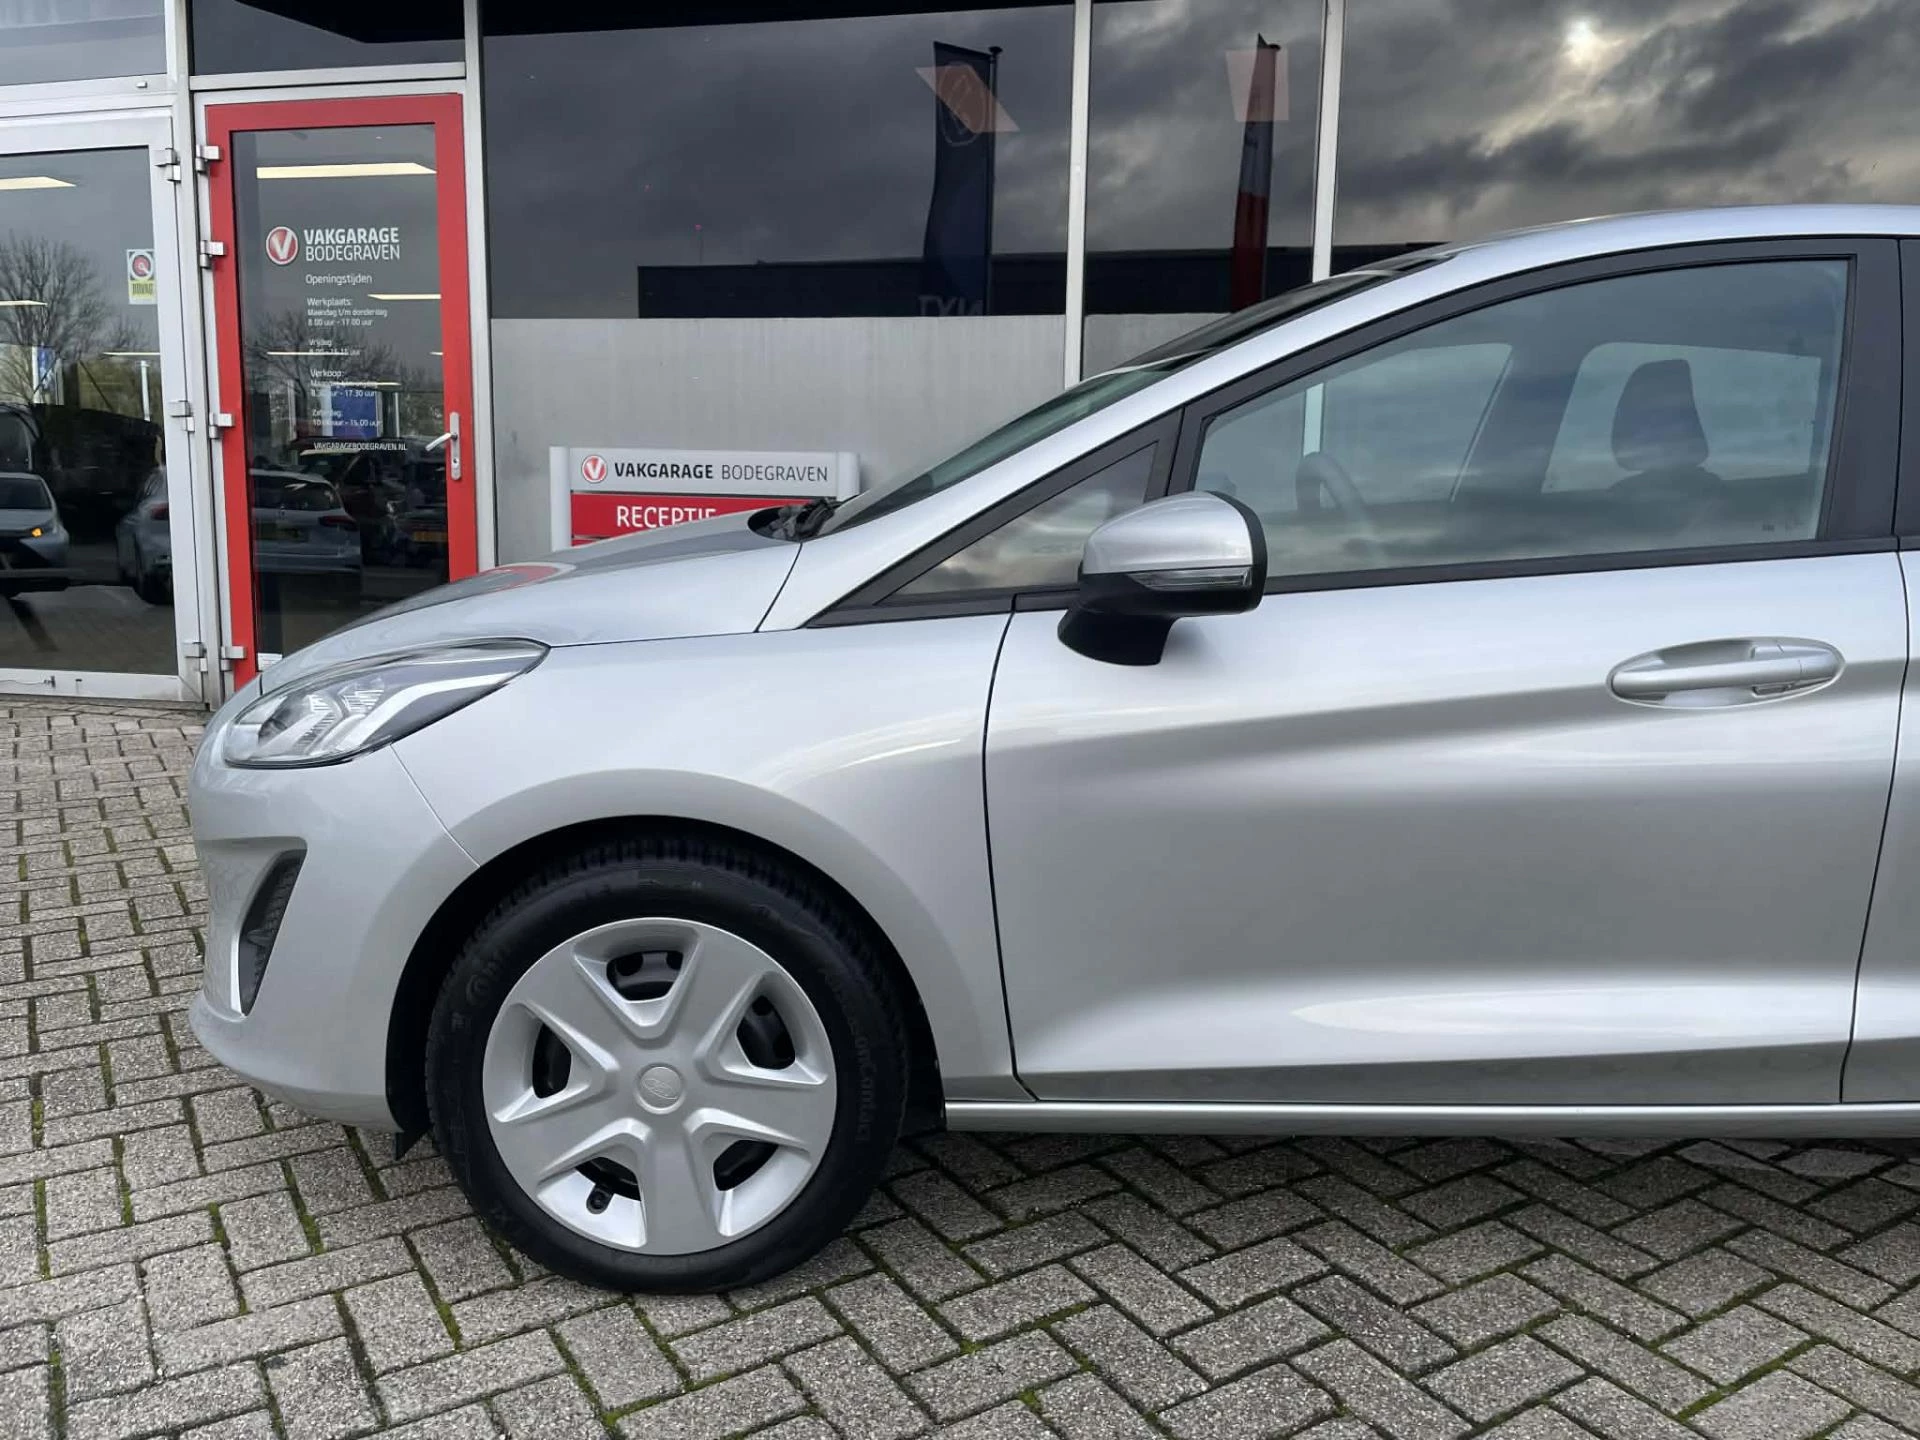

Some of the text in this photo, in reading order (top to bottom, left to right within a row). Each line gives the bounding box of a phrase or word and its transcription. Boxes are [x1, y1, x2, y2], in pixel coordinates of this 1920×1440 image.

[304, 228, 399, 245] VAKGARAGE
[305, 244, 401, 262] BODEGRAVEN
[305, 273, 373, 286] Openingstijden
[307, 297, 353, 308] Werkplaats:
[310, 369, 345, 379] Verkoop:
[313, 441, 408, 451] VAKGARAGEBODEGRAVEN.NL
[614, 462, 714, 480] VAKGARAGE
[721, 465, 828, 482] BODEGRAVEN
